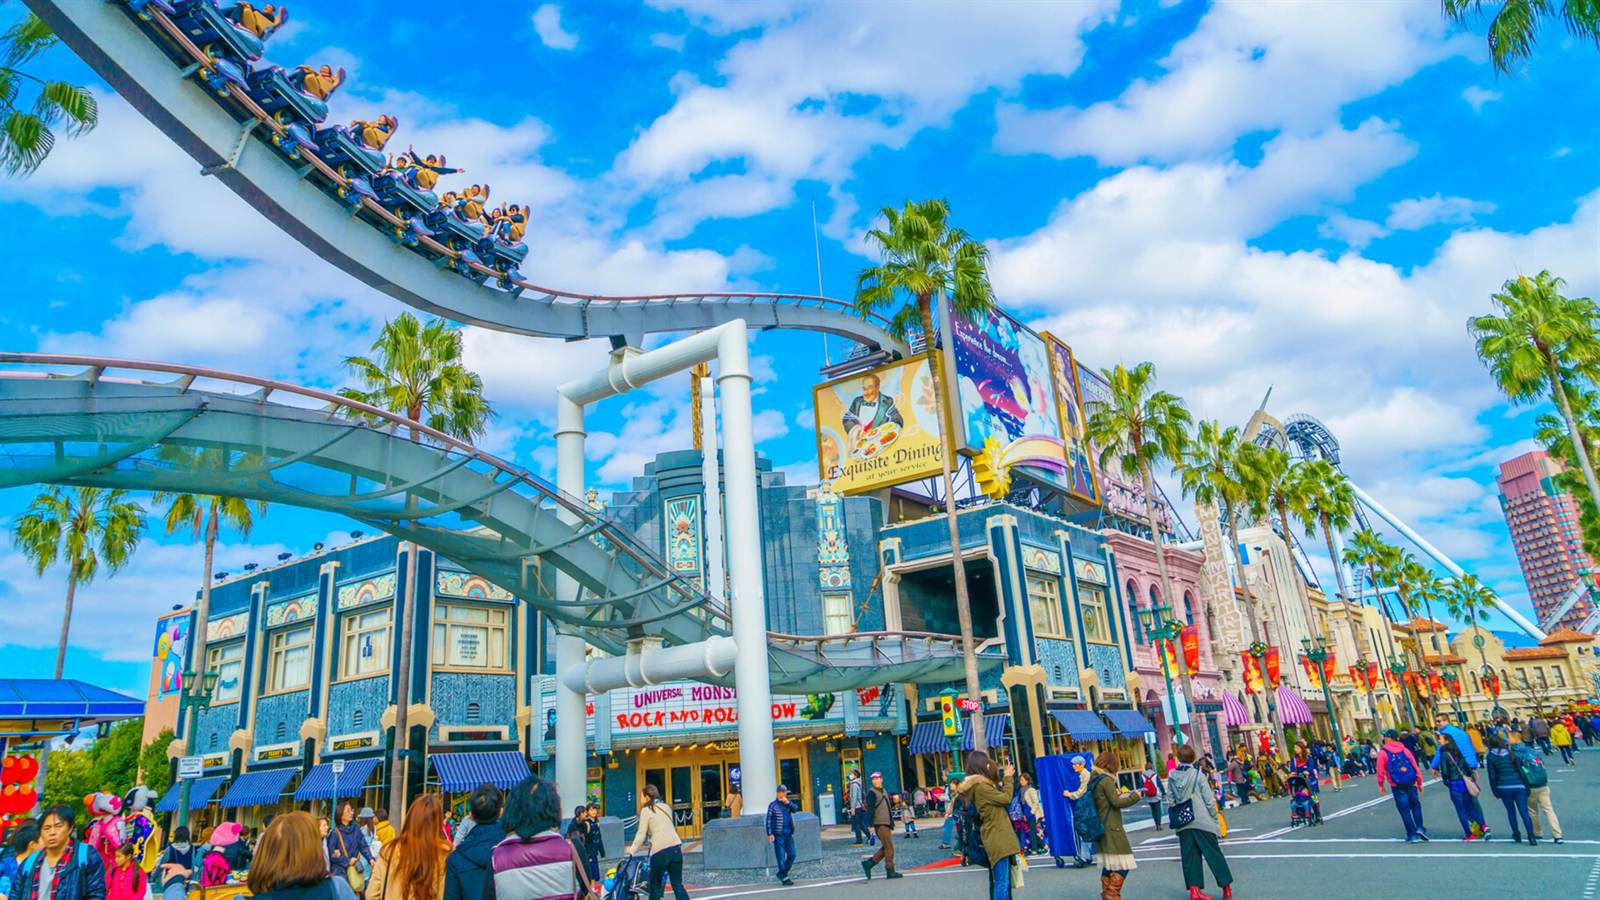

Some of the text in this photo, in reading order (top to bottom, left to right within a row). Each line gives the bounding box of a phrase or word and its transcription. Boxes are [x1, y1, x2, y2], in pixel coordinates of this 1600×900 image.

[828, 443, 944, 481] Exquisite Dining
[866, 461, 928, 481] at your service
[634, 685, 737, 708] UNIVERSAL MONST
[962, 699, 979, 711] STOP
[616, 703, 796, 729] ROCK AND ROL OW
